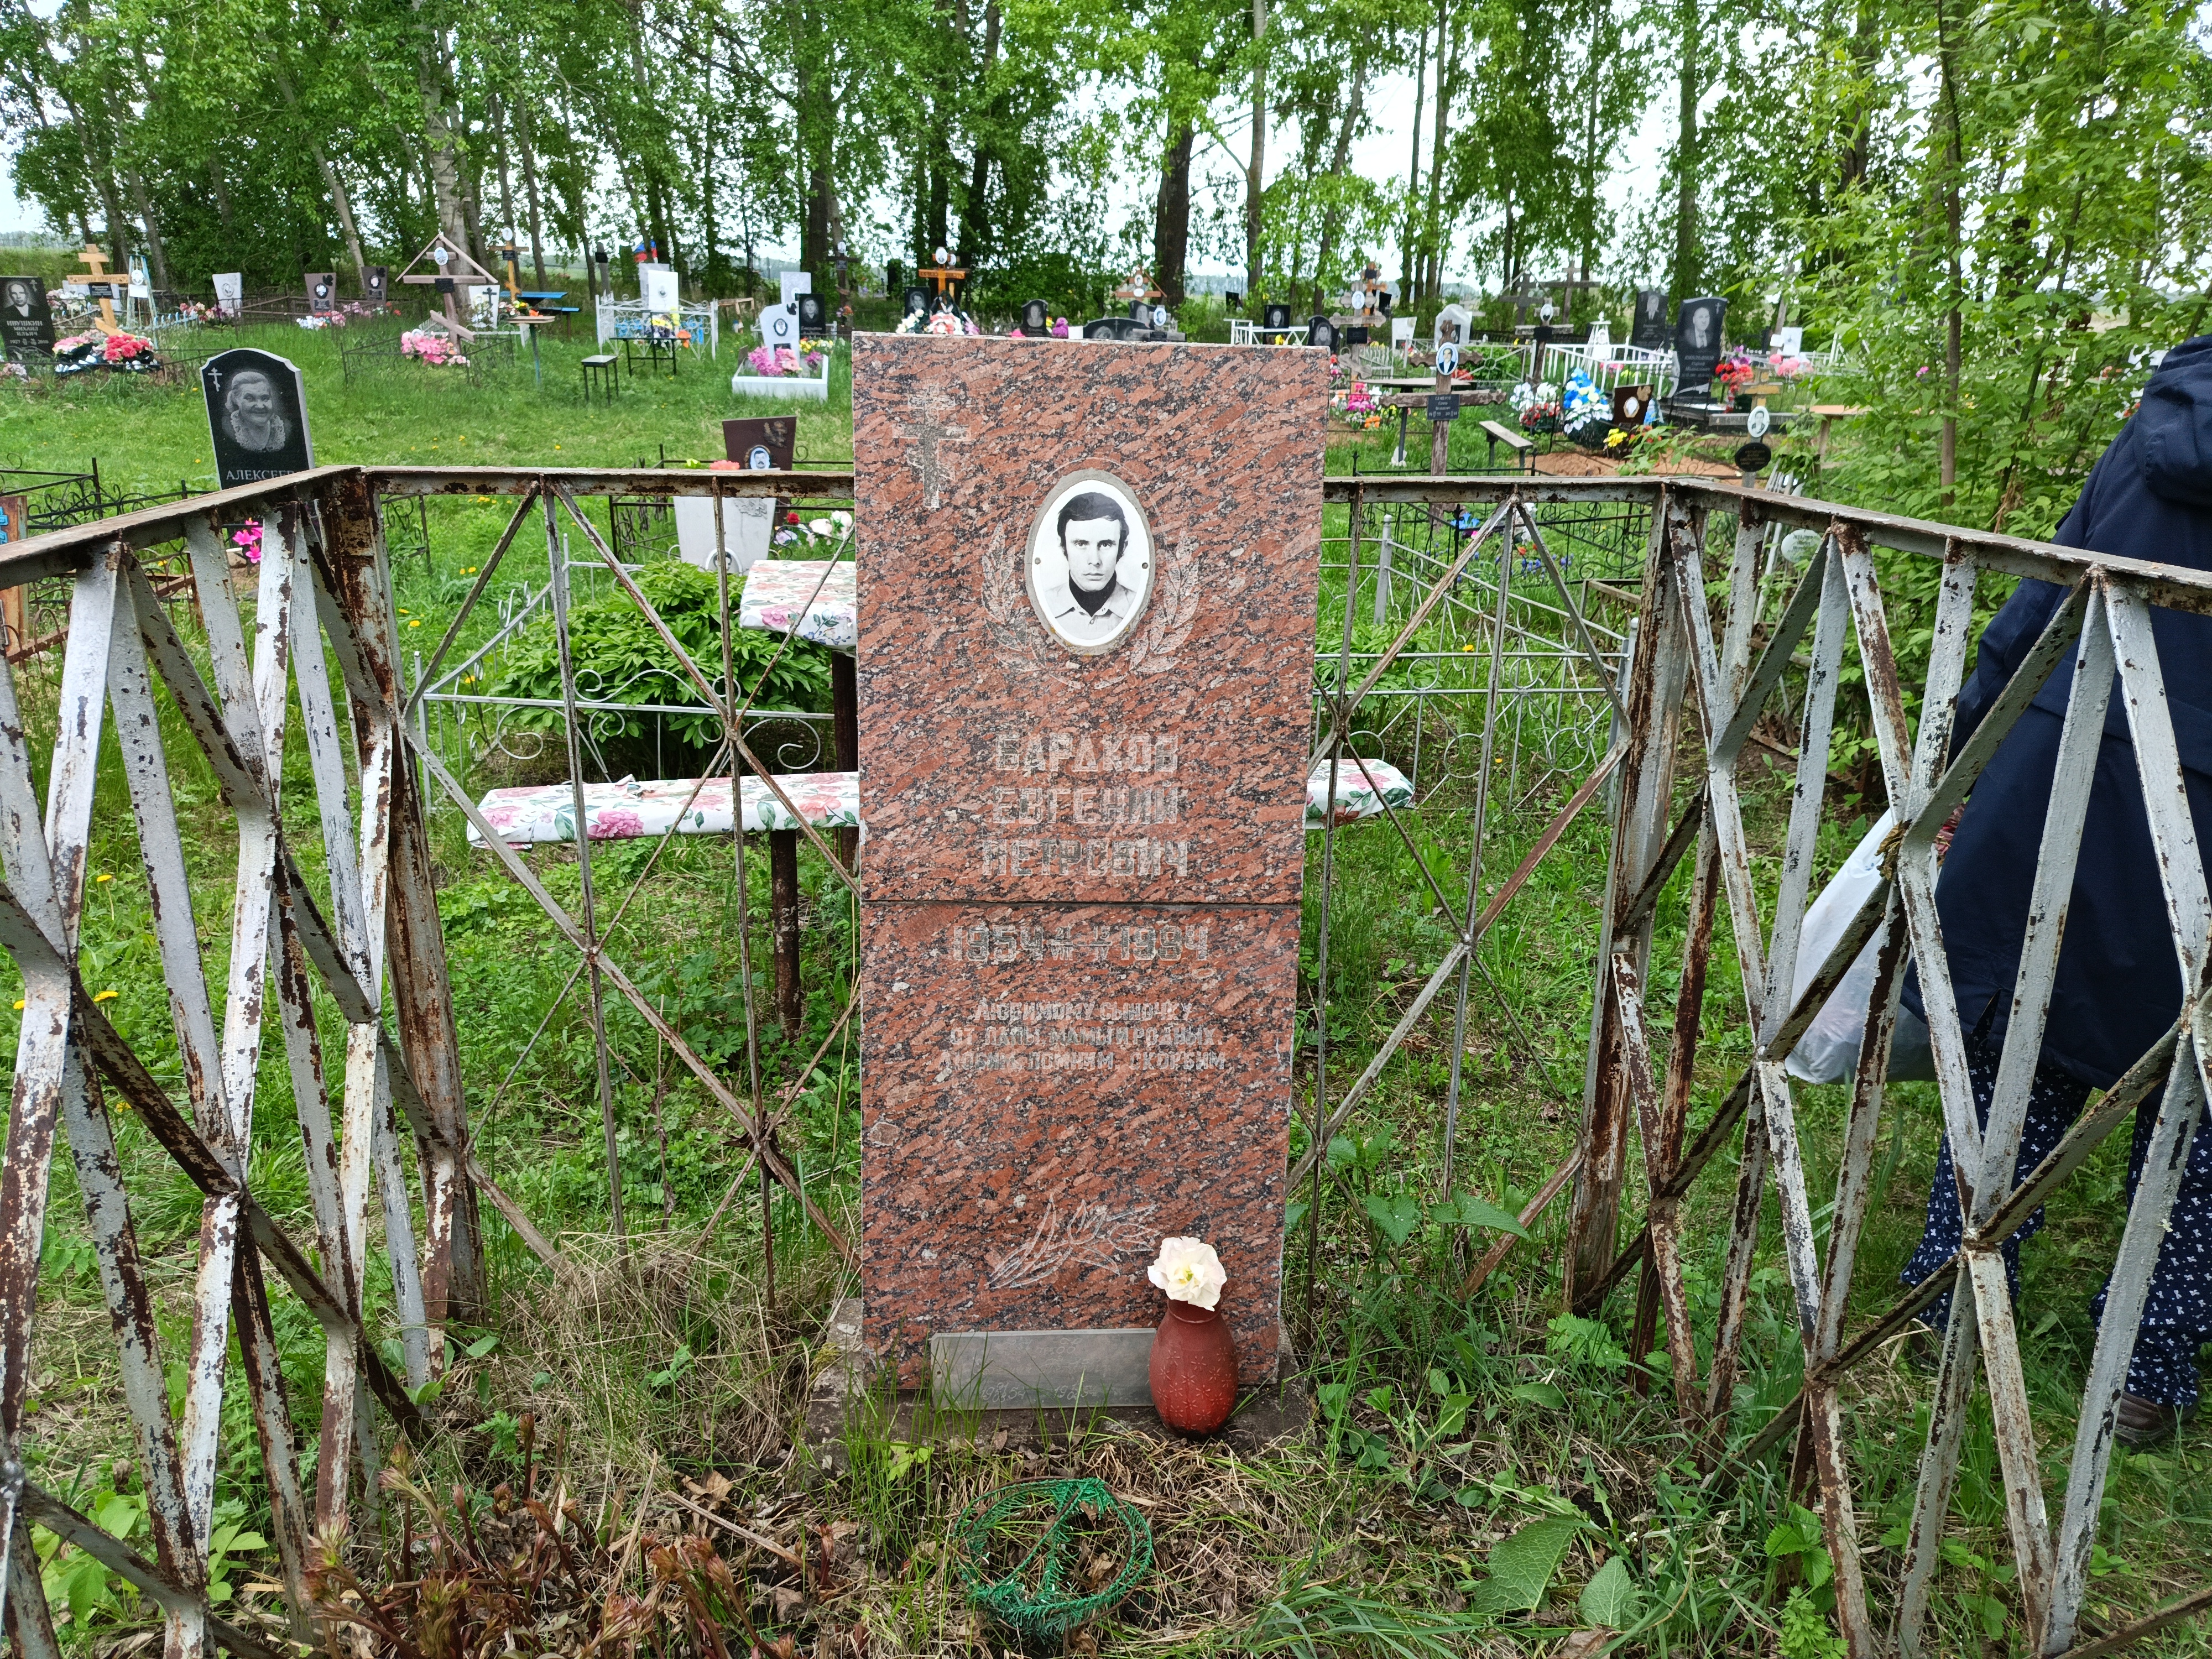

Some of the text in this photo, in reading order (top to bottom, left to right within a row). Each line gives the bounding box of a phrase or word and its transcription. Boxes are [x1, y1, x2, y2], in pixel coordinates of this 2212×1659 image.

[996, 734, 1178, 772] БАРАКОВ
[993, 781, 1178, 825] ЕВГЕНИЙ
[983, 837, 1189, 877] ПЕТРОВИЧ
[953, 925, 1044, 962] 1954
[1120, 925, 1208, 961] 1984
